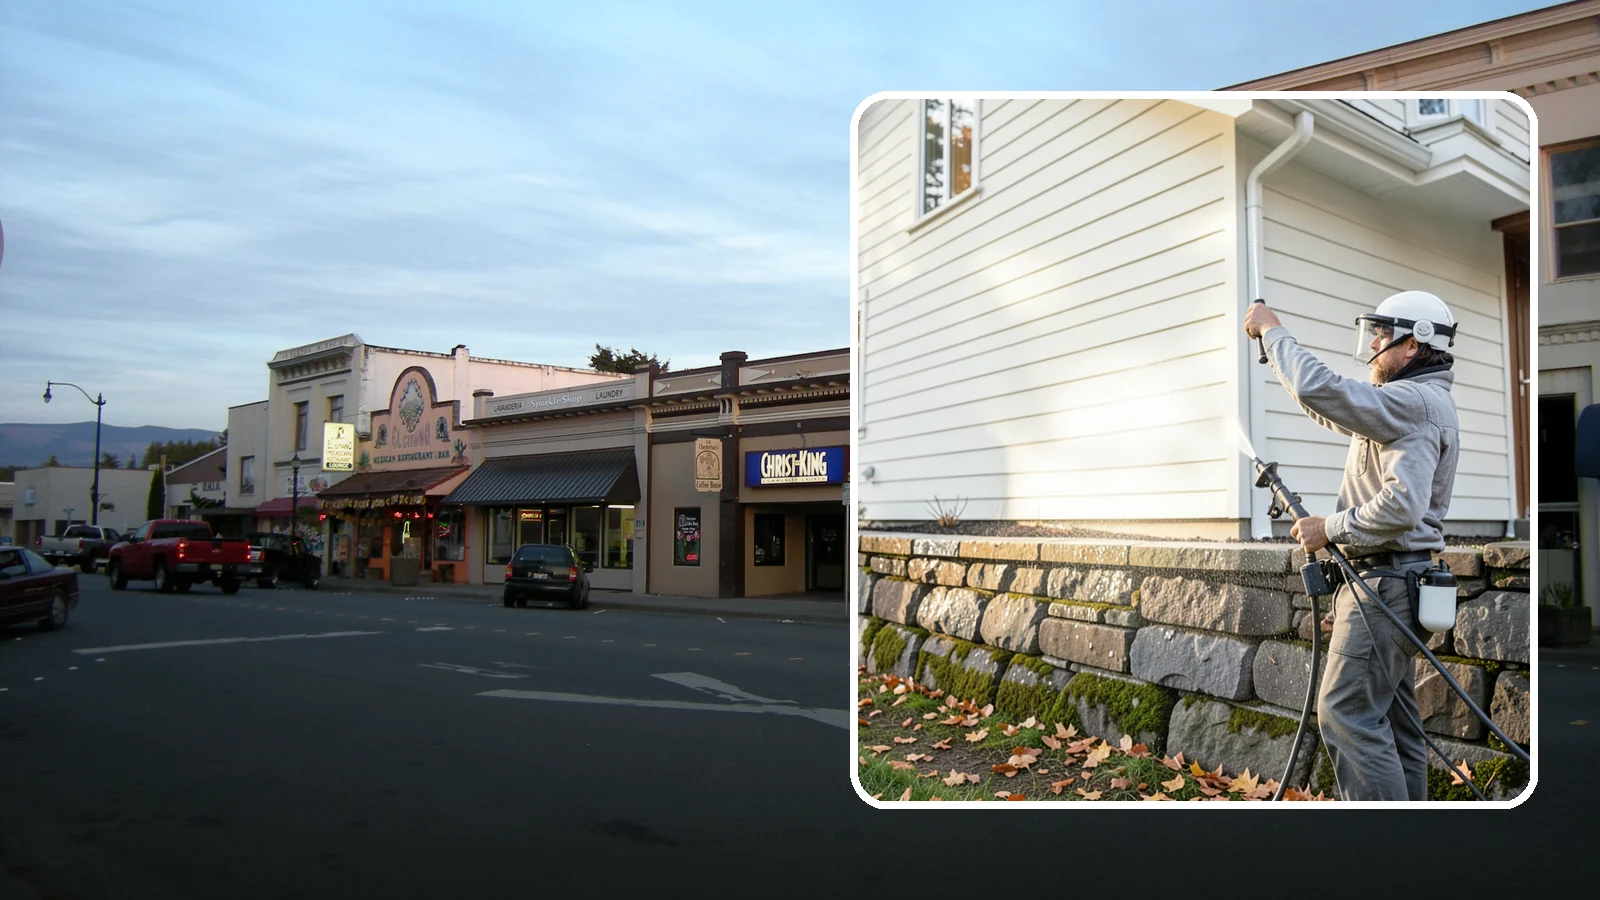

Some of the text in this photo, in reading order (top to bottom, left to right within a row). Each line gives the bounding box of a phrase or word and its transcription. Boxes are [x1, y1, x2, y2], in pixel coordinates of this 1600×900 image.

[595, 389, 623, 400] LAUNDRY
[493, 402, 522, 412] LAVANDERIA
[531, 394, 582, 408] Sparkle Shop
[397, 451, 433, 462] RESTAURANT
[437, 450, 450, 459] BAR
[761, 450, 827, 477] CHRIST KING
